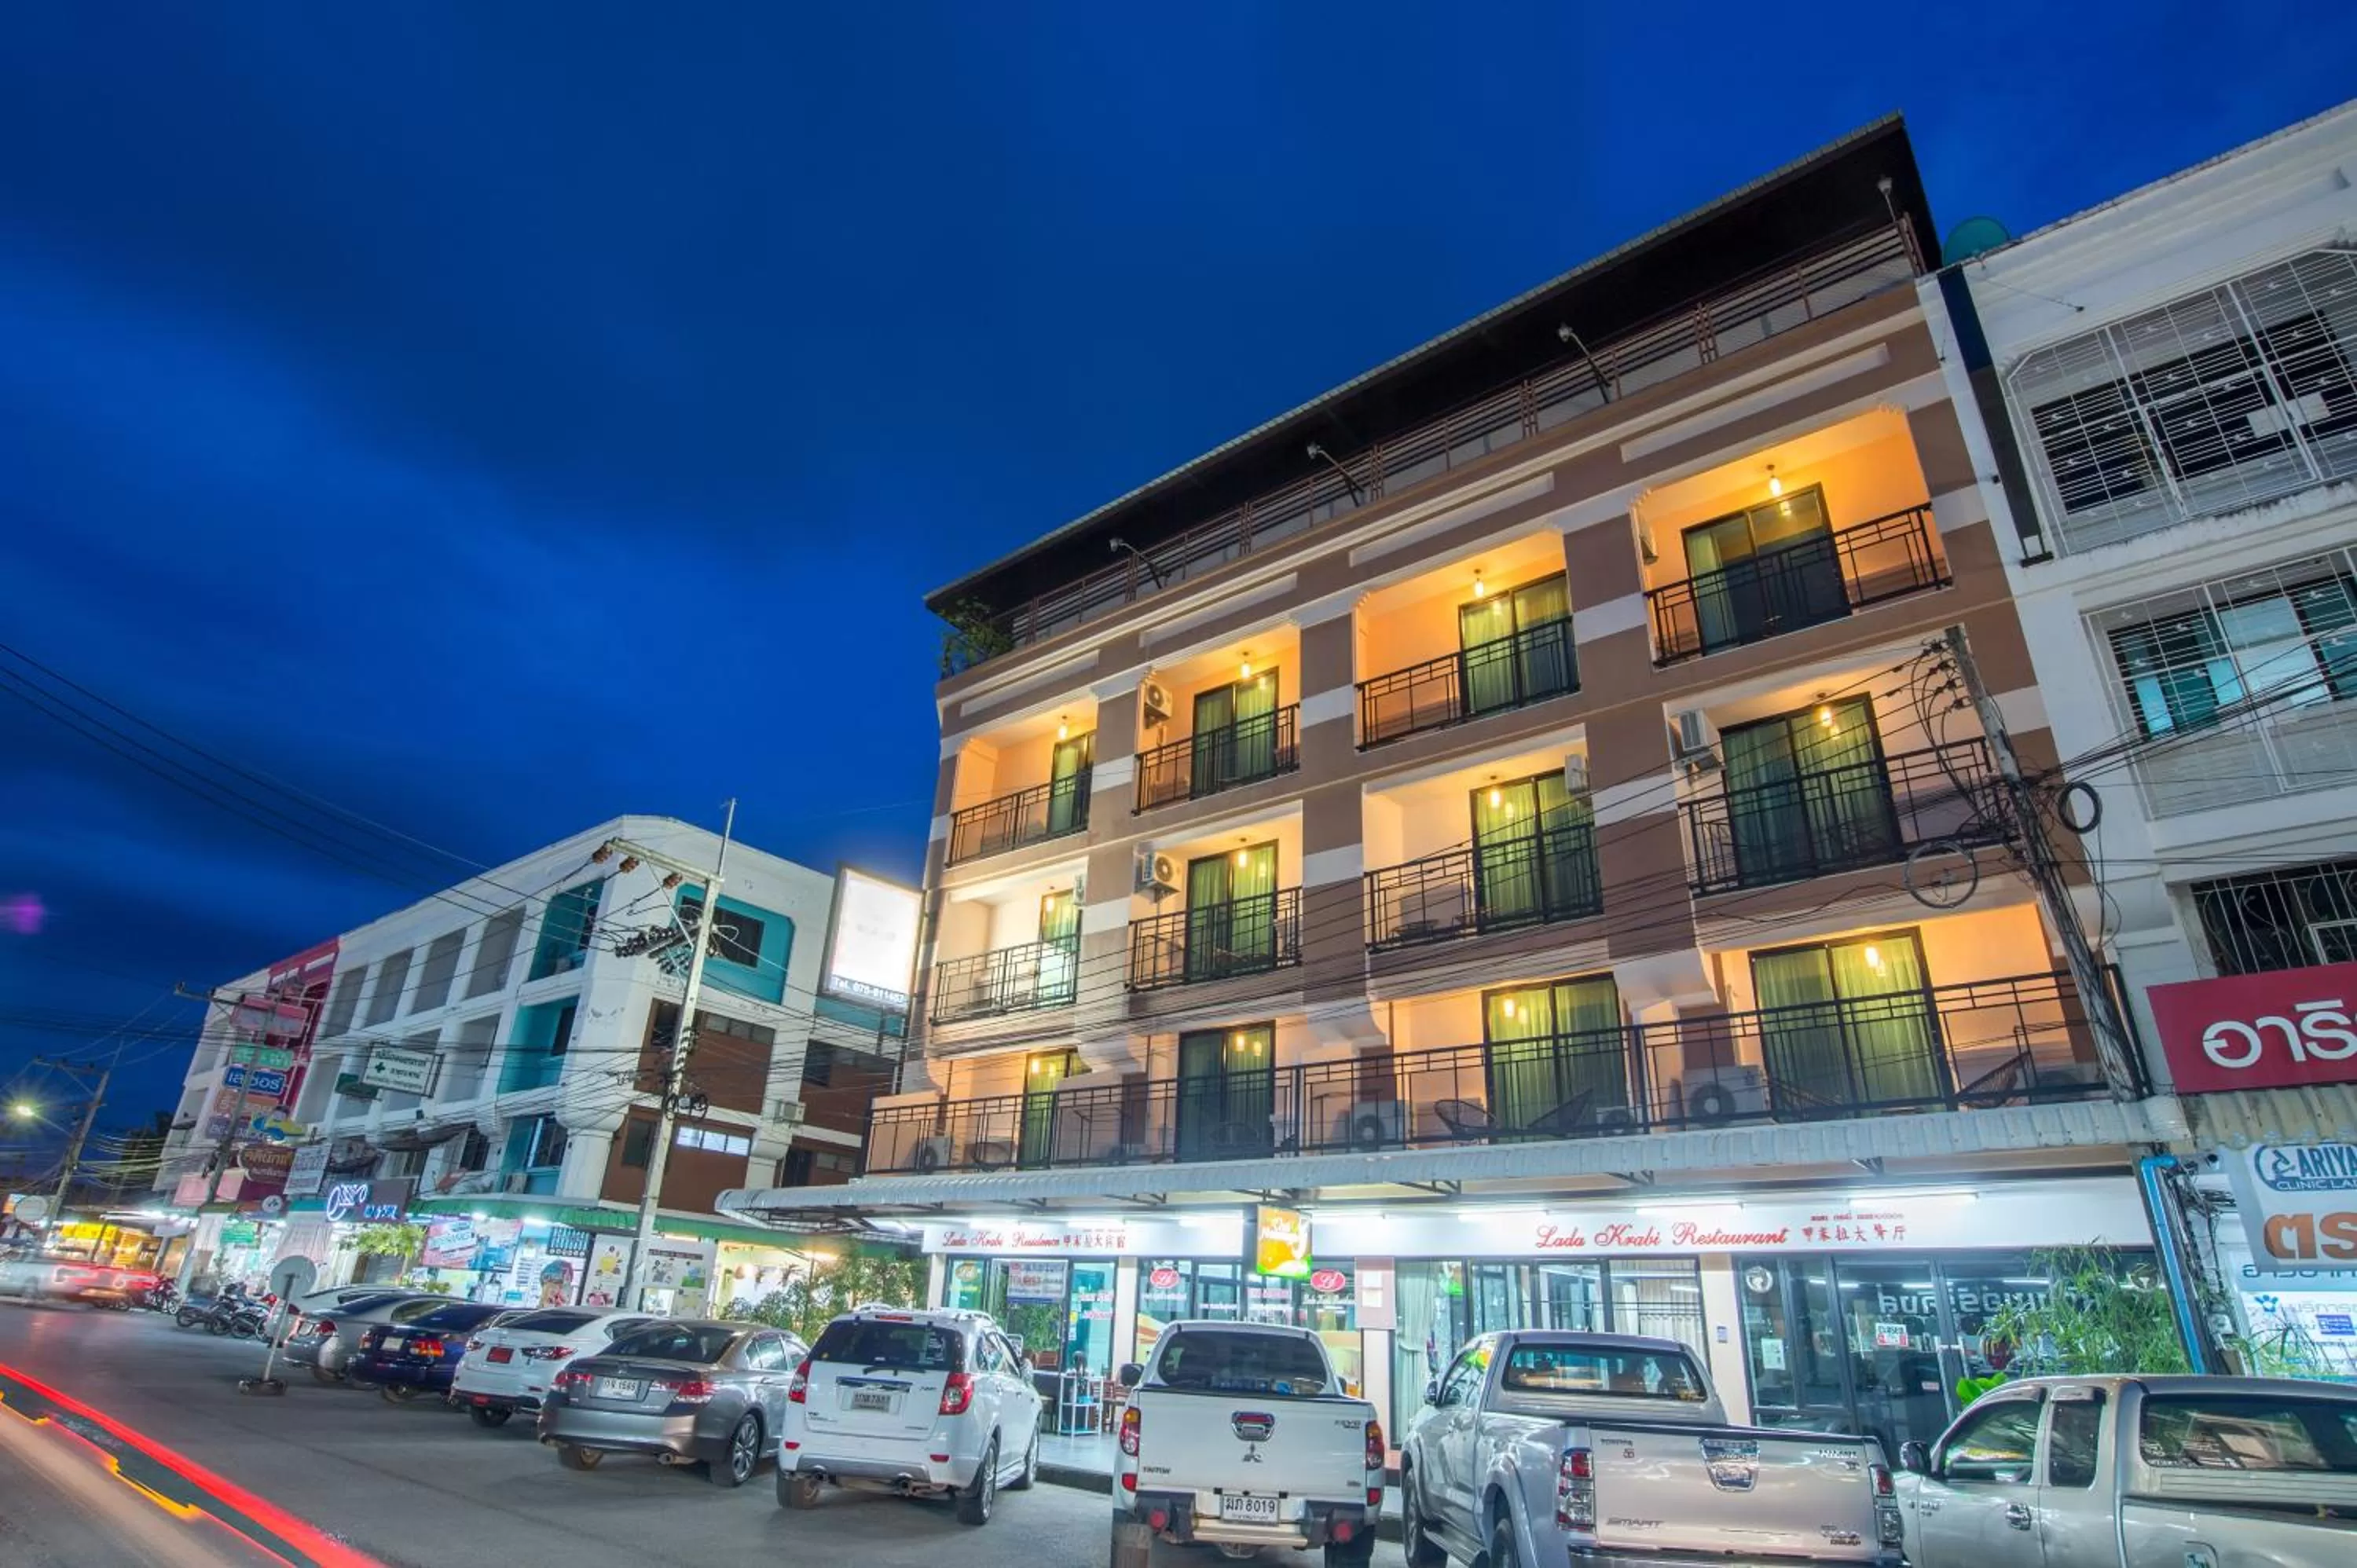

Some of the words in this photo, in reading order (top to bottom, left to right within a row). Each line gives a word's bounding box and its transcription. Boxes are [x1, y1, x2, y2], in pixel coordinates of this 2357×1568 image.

[2202, 998, 2357, 1068] อาริ
[2276, 1178, 2328, 1191] CLINIC
[2330, 1178, 2357, 1189] LA
[1534, 1224, 1586, 1248] Lada
[1594, 1222, 1662, 1247] Krabi
[1671, 1222, 1791, 1246] Restaurant
[1245, 1499, 1275, 1513] 8019
